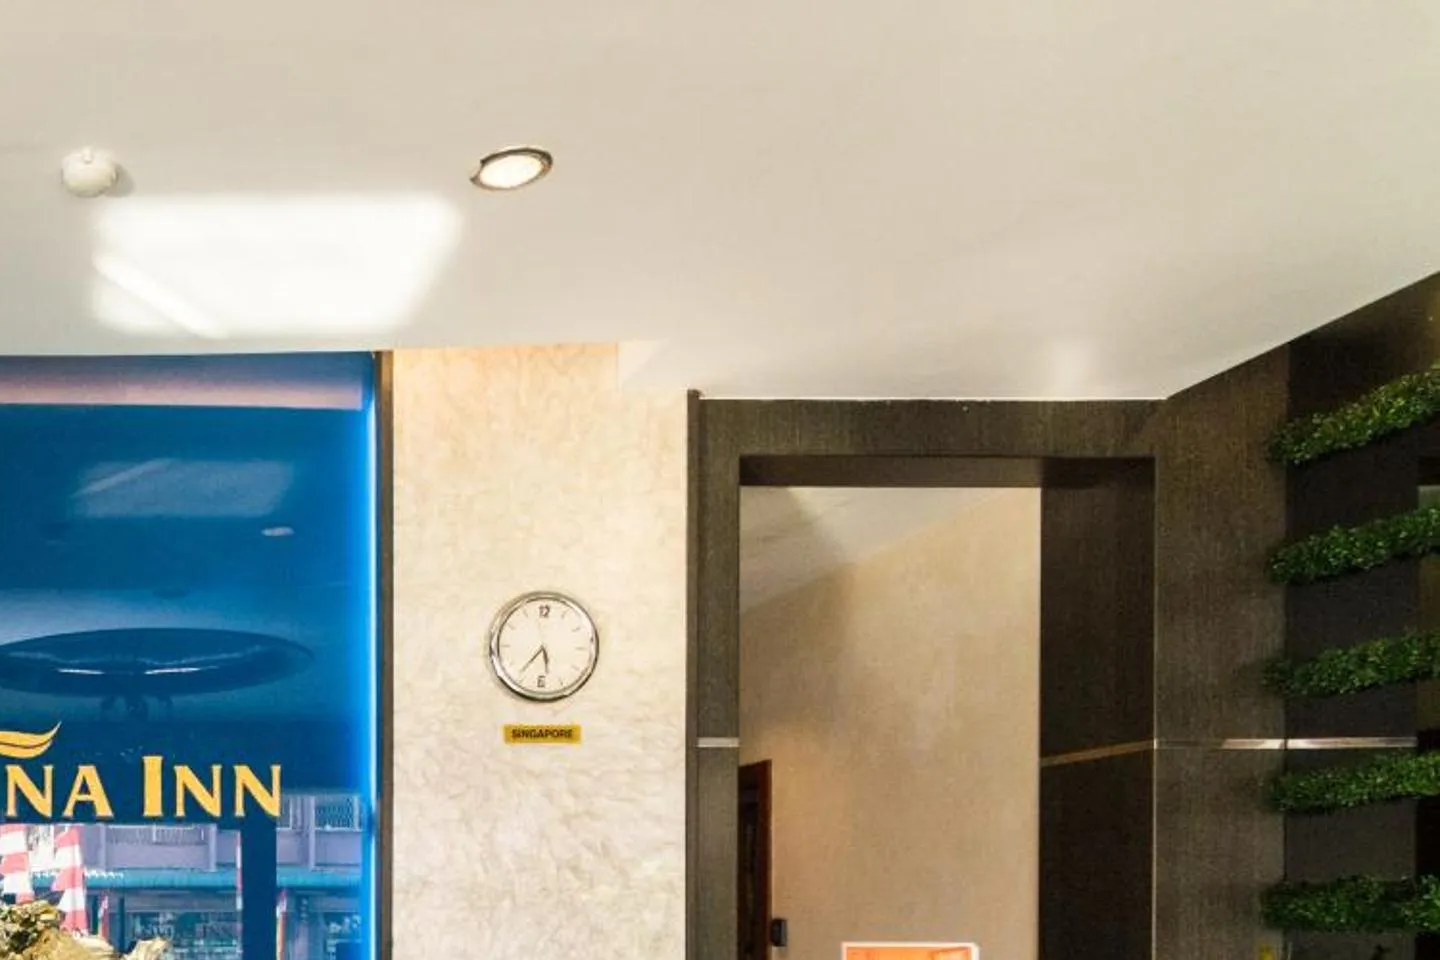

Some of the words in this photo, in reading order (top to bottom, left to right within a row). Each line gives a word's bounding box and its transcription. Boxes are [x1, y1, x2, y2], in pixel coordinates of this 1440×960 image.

[538, 604, 551, 618] 12
[511, 728, 574, 740] SINGAPORE
[142, 755, 282, 818] INN
